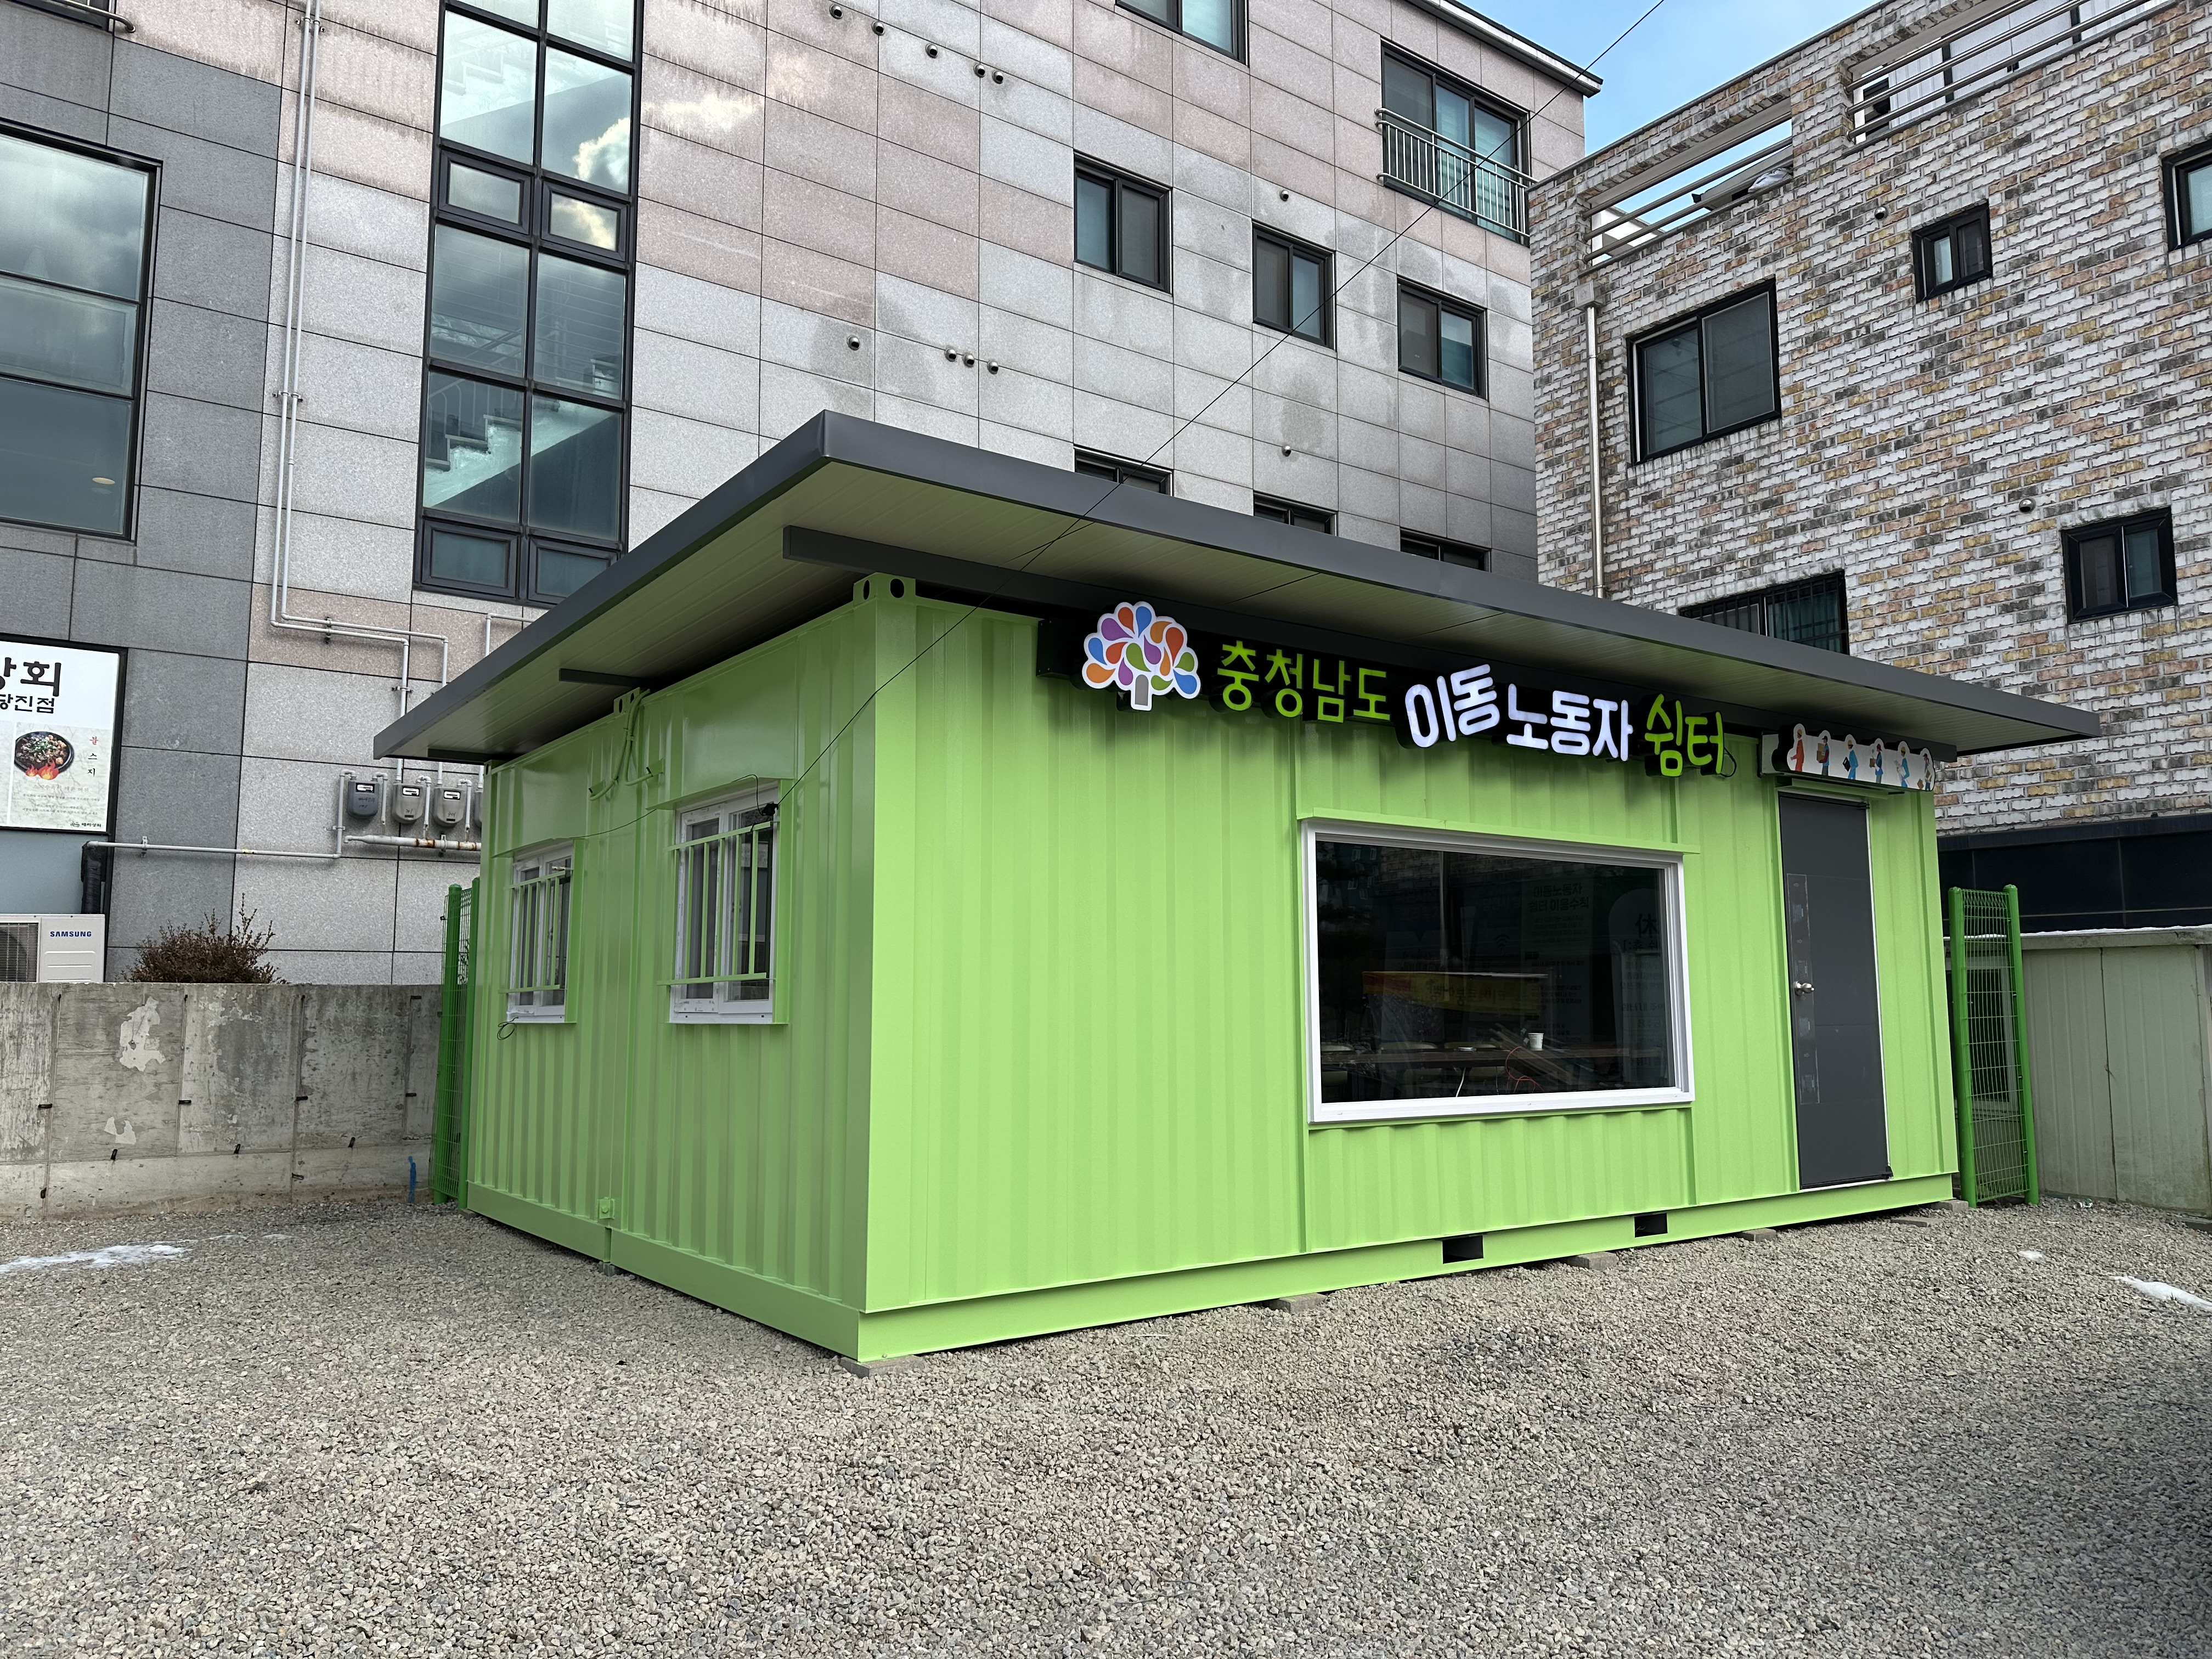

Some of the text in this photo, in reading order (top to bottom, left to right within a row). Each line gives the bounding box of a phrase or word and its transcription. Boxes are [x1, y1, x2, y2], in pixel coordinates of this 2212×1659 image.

[1216, 640, 1724, 777] 충청남도 이동 노동자 쉼터
[1533, 882, 1583, 898] 이동노동자
